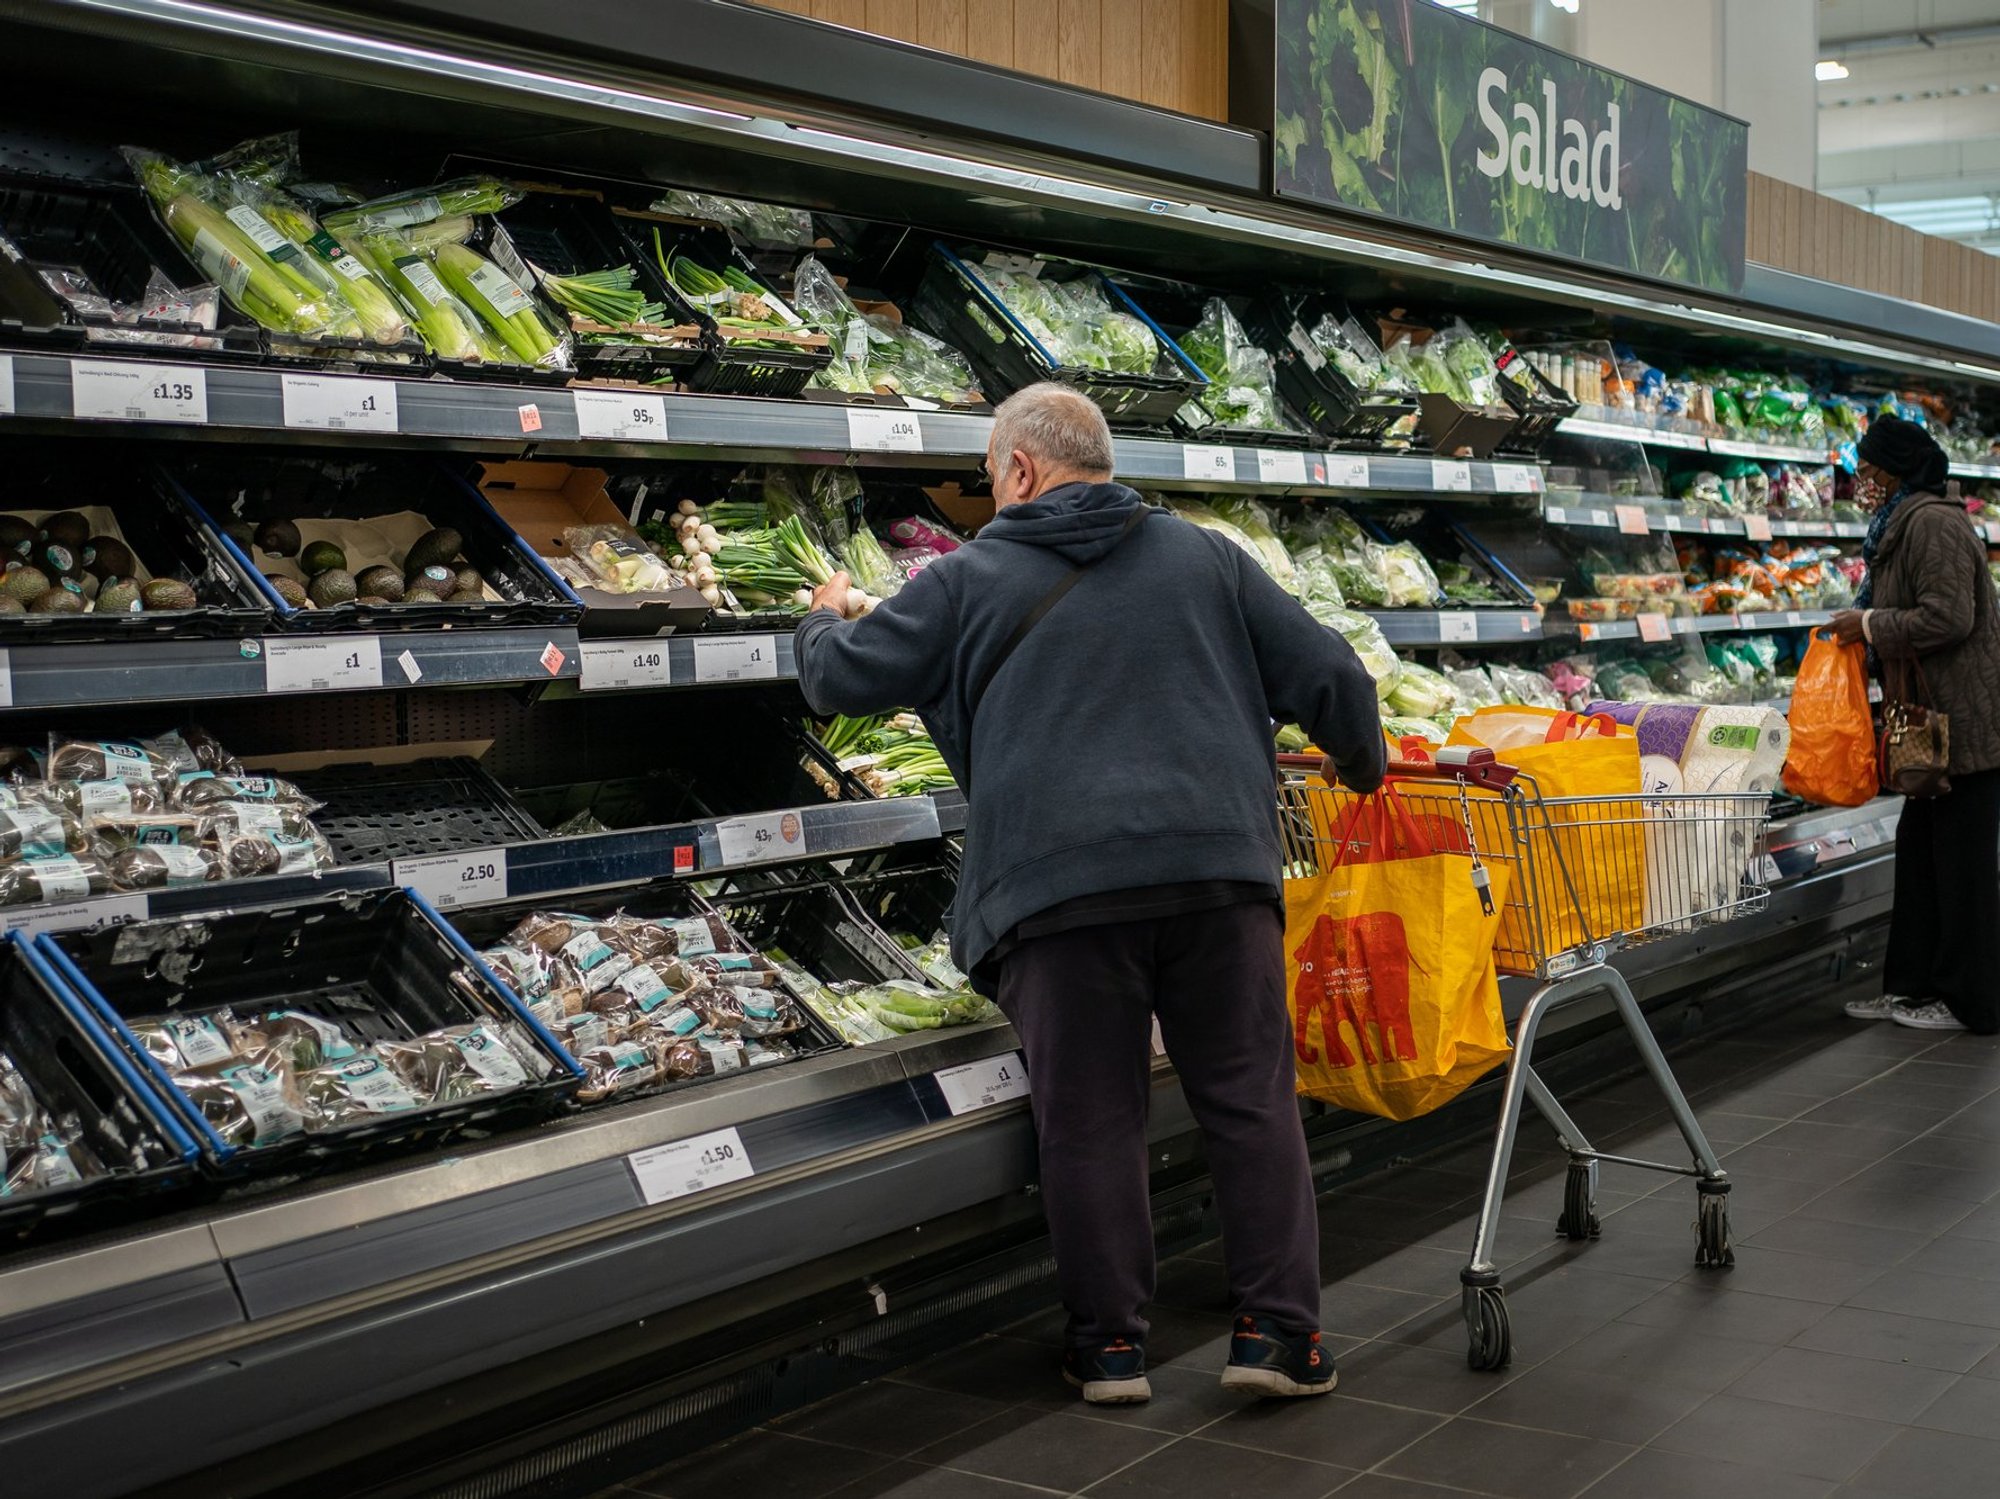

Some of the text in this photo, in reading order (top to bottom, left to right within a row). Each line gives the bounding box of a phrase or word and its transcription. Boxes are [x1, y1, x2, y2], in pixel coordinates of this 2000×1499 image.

[1477, 67, 1622, 211] Salad
[154, 383, 193, 400] £1.35
[362, 395, 376, 411] £1
[633, 408, 654, 424] 95p
[892, 423, 914, 434] £1.04
[346, 652, 360, 668] £1
[633, 654, 660, 667] £1.40
[751, 648, 761, 661] £1
[755, 829, 772, 842] 43p
[462, 864, 495, 881] £2.50
[998, 1066, 1011, 1082] £1
[701, 1144, 734, 1166] £1.50
